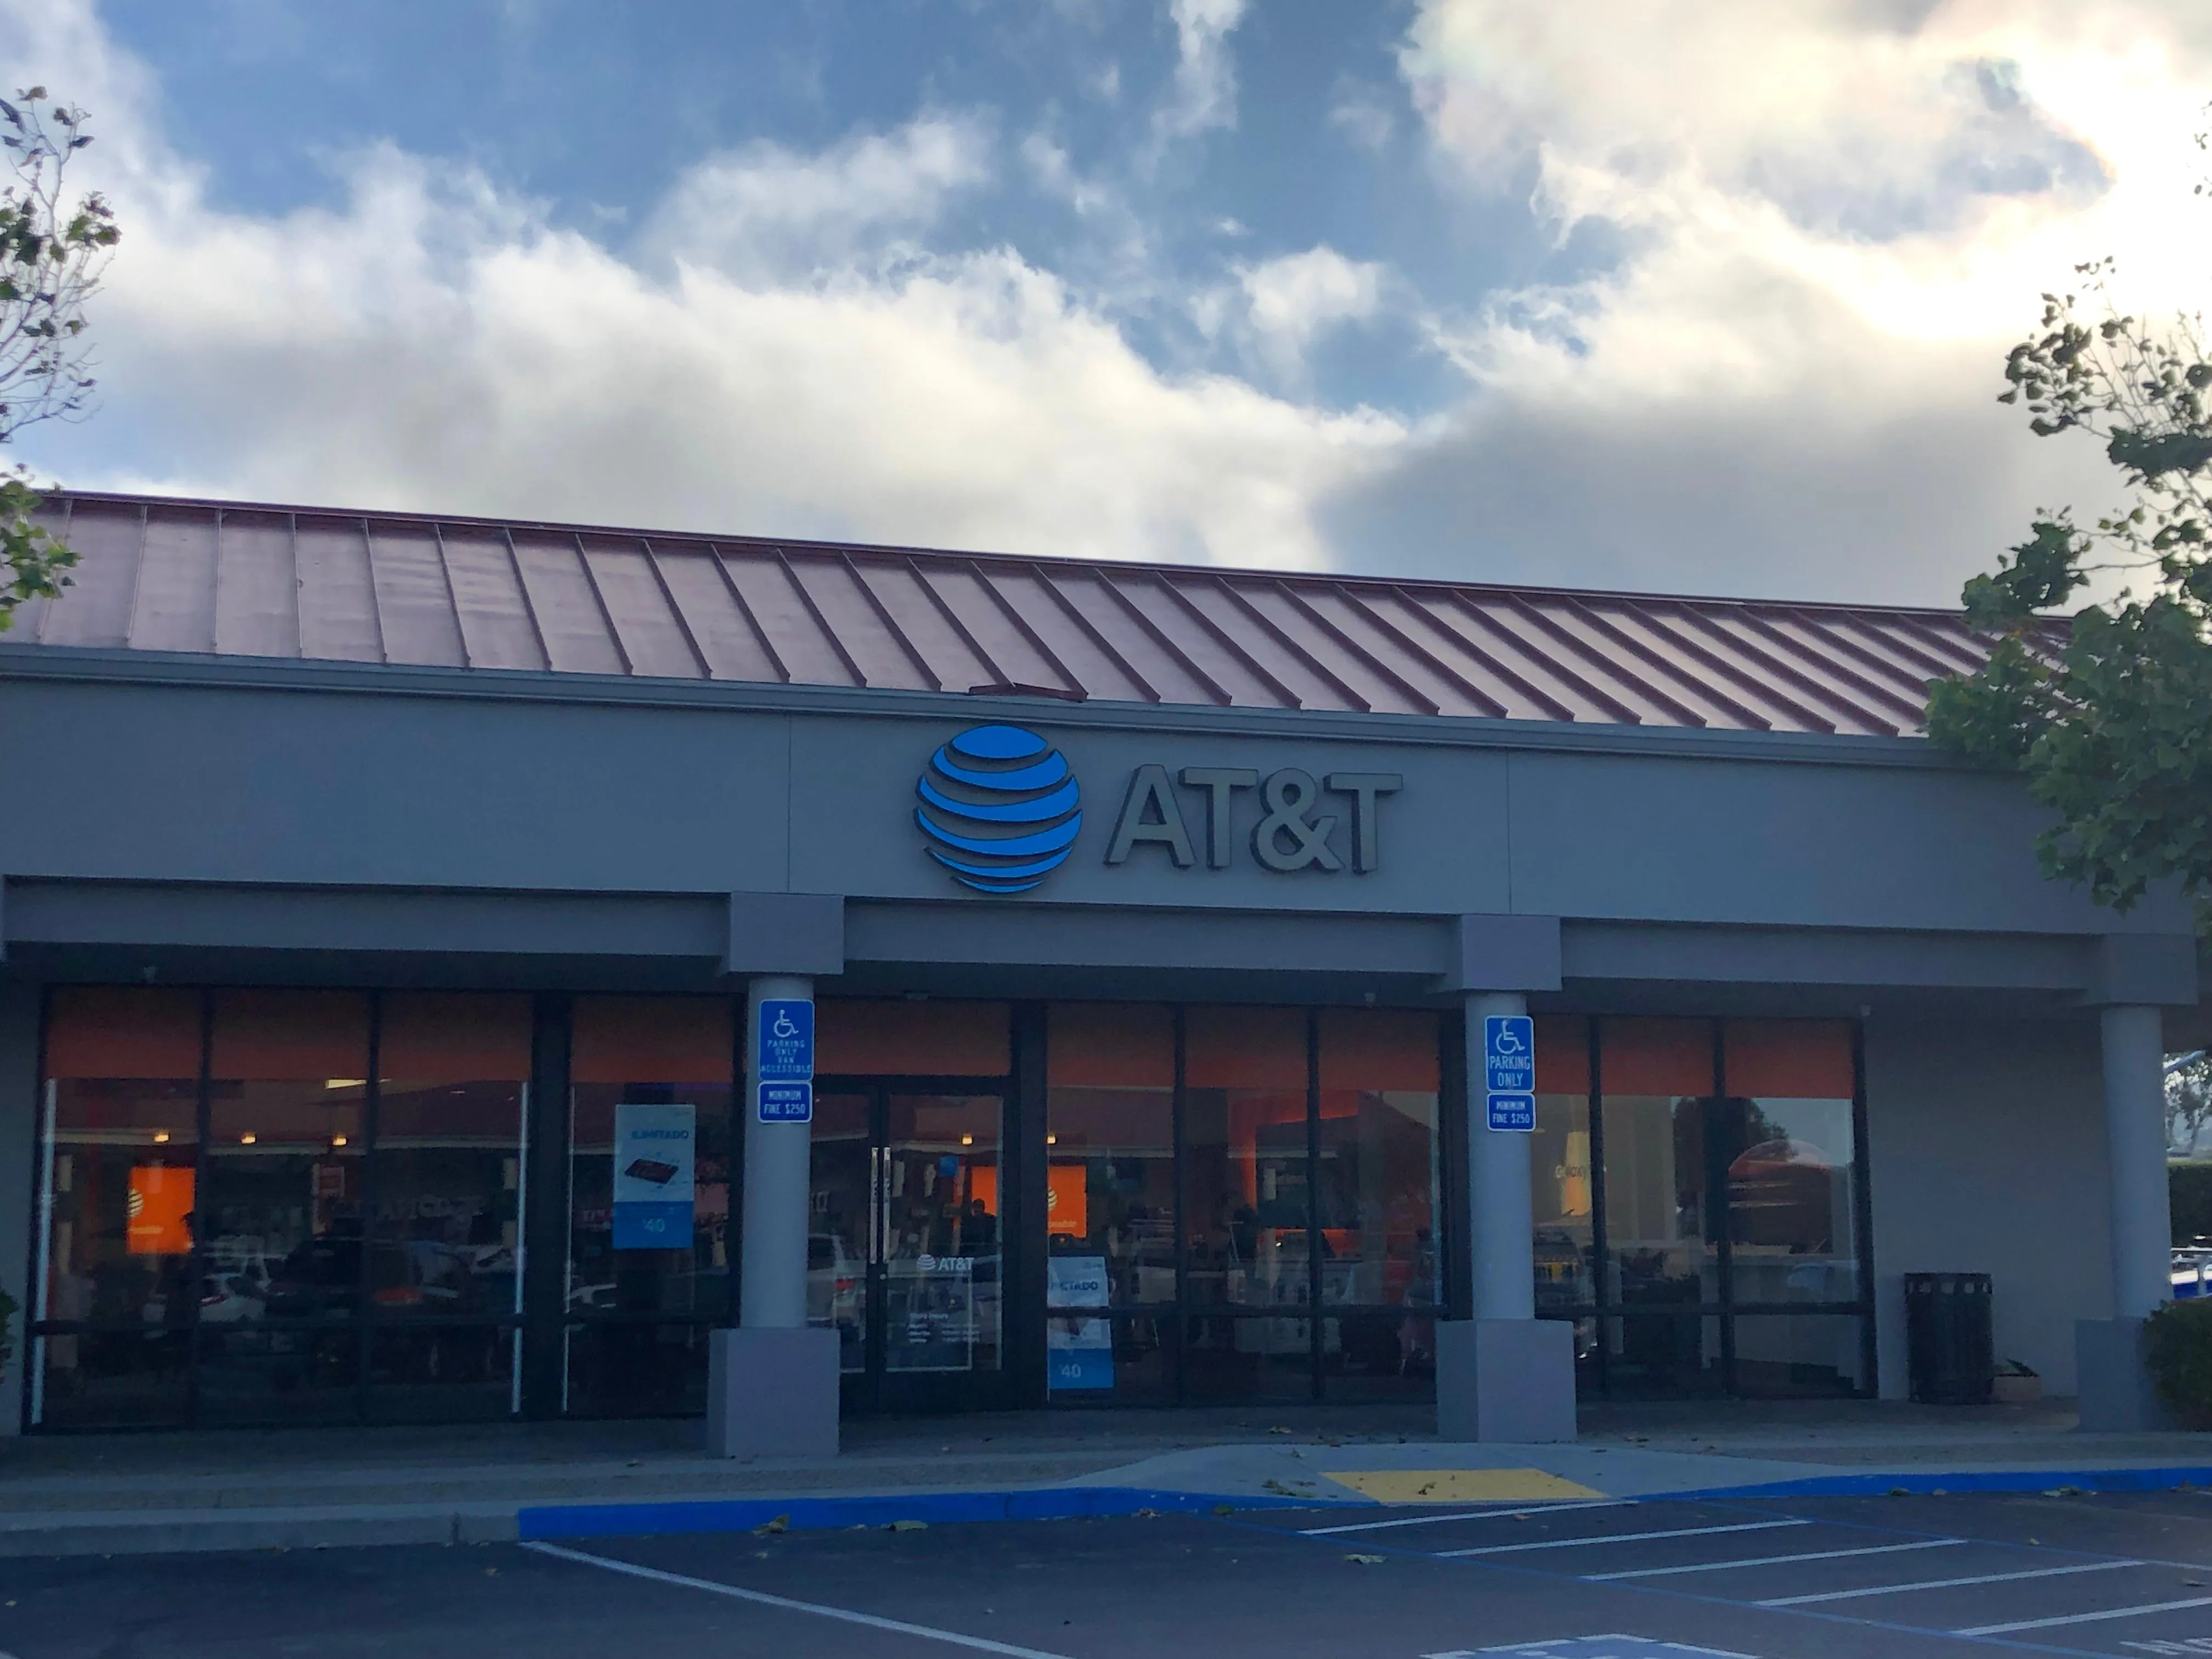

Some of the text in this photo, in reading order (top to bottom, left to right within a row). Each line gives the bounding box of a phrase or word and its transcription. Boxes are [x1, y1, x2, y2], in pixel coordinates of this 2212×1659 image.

[1103, 763, 1403, 875] AT&T
[761, 1064, 811, 1073] ACCESSIBLE
[1489, 1056, 1531, 1070] PARKING
[1497, 1073, 1523, 1087] ONLY
[769, 1091, 801, 1100] MINIMUM
[764, 1104, 806, 1114] FINE $250
[1492, 1113, 1530, 1124] FINE $250
[938, 1257, 974, 1271] AT&T
